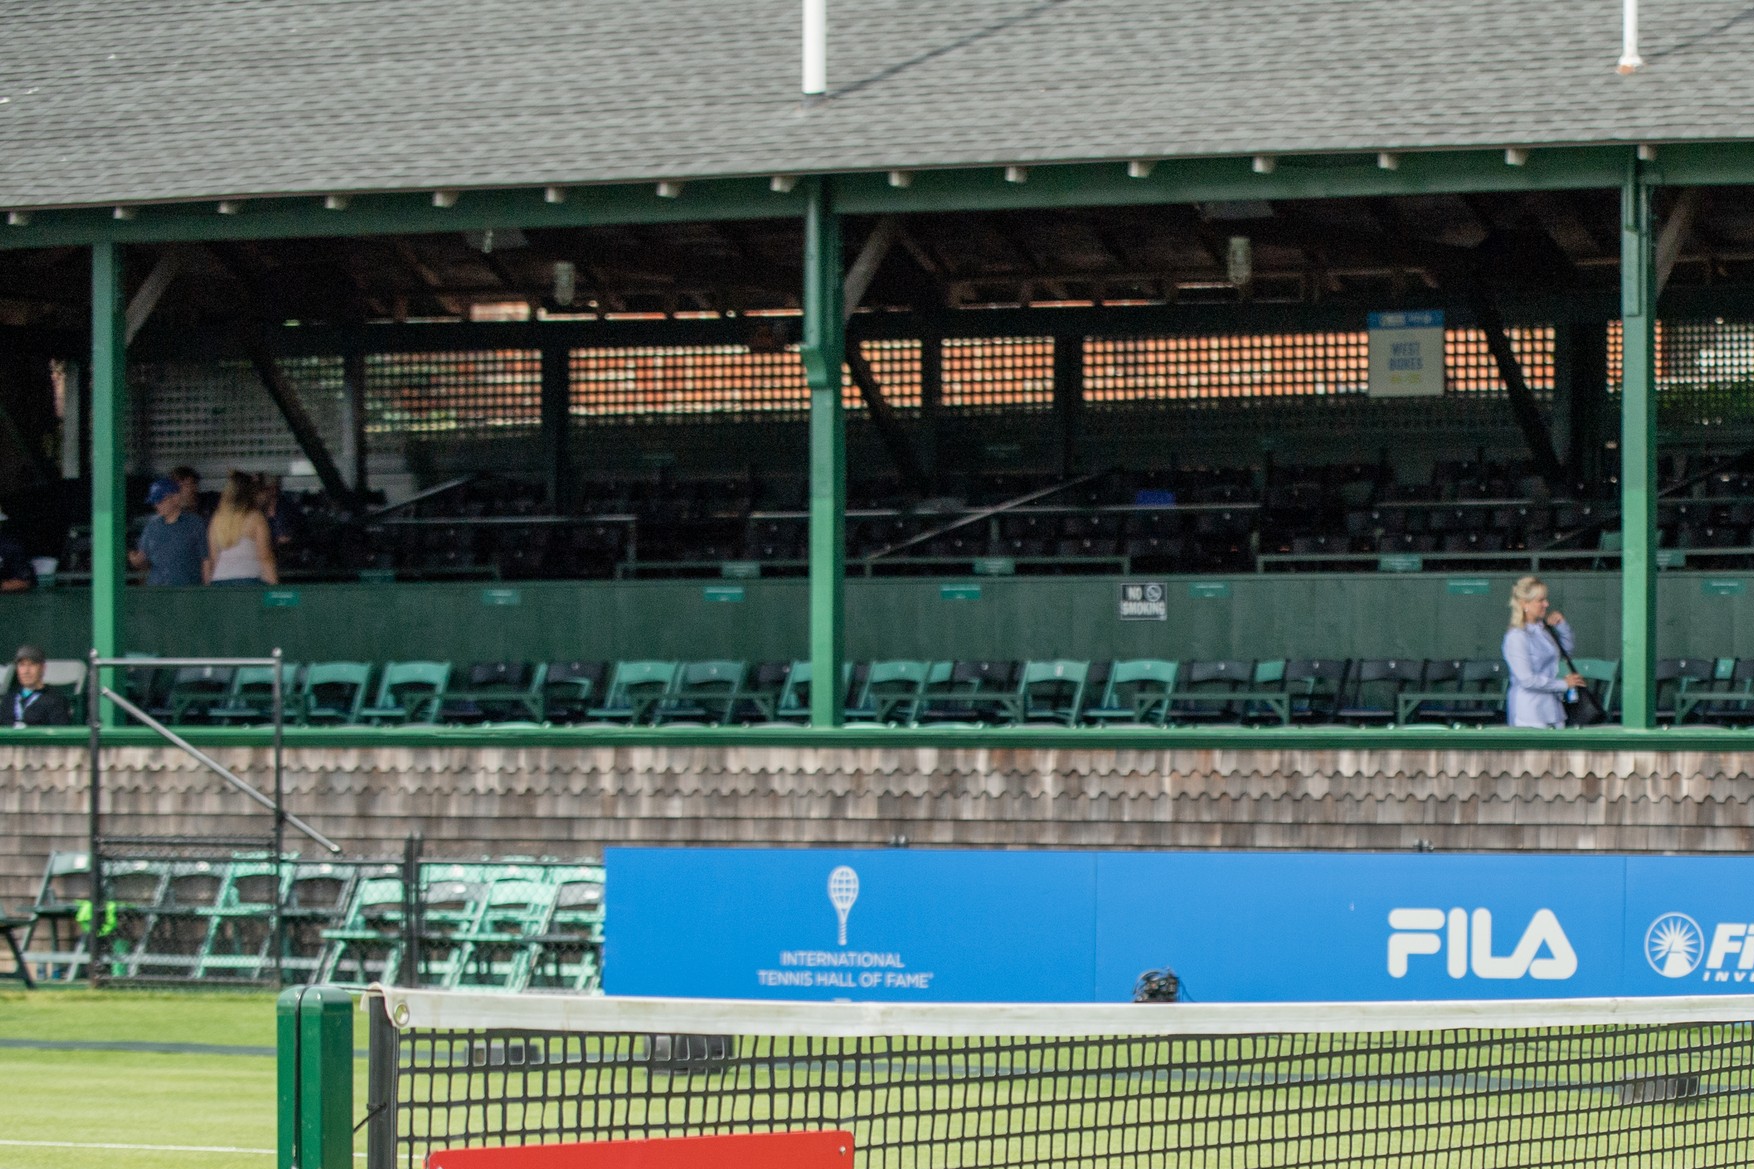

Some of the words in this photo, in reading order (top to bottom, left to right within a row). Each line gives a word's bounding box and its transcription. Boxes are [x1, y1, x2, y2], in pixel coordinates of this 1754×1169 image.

[1127, 586, 1143, 600] NO
[1121, 601, 1166, 616] SMOKING
[1388, 908, 1578, 980] FILA
[780, 951, 905, 968] INTERNATIONAL
[757, 969, 813, 987] TENNIS
[815, 971, 858, 988] HALL
[858, 972, 883, 988] OF
